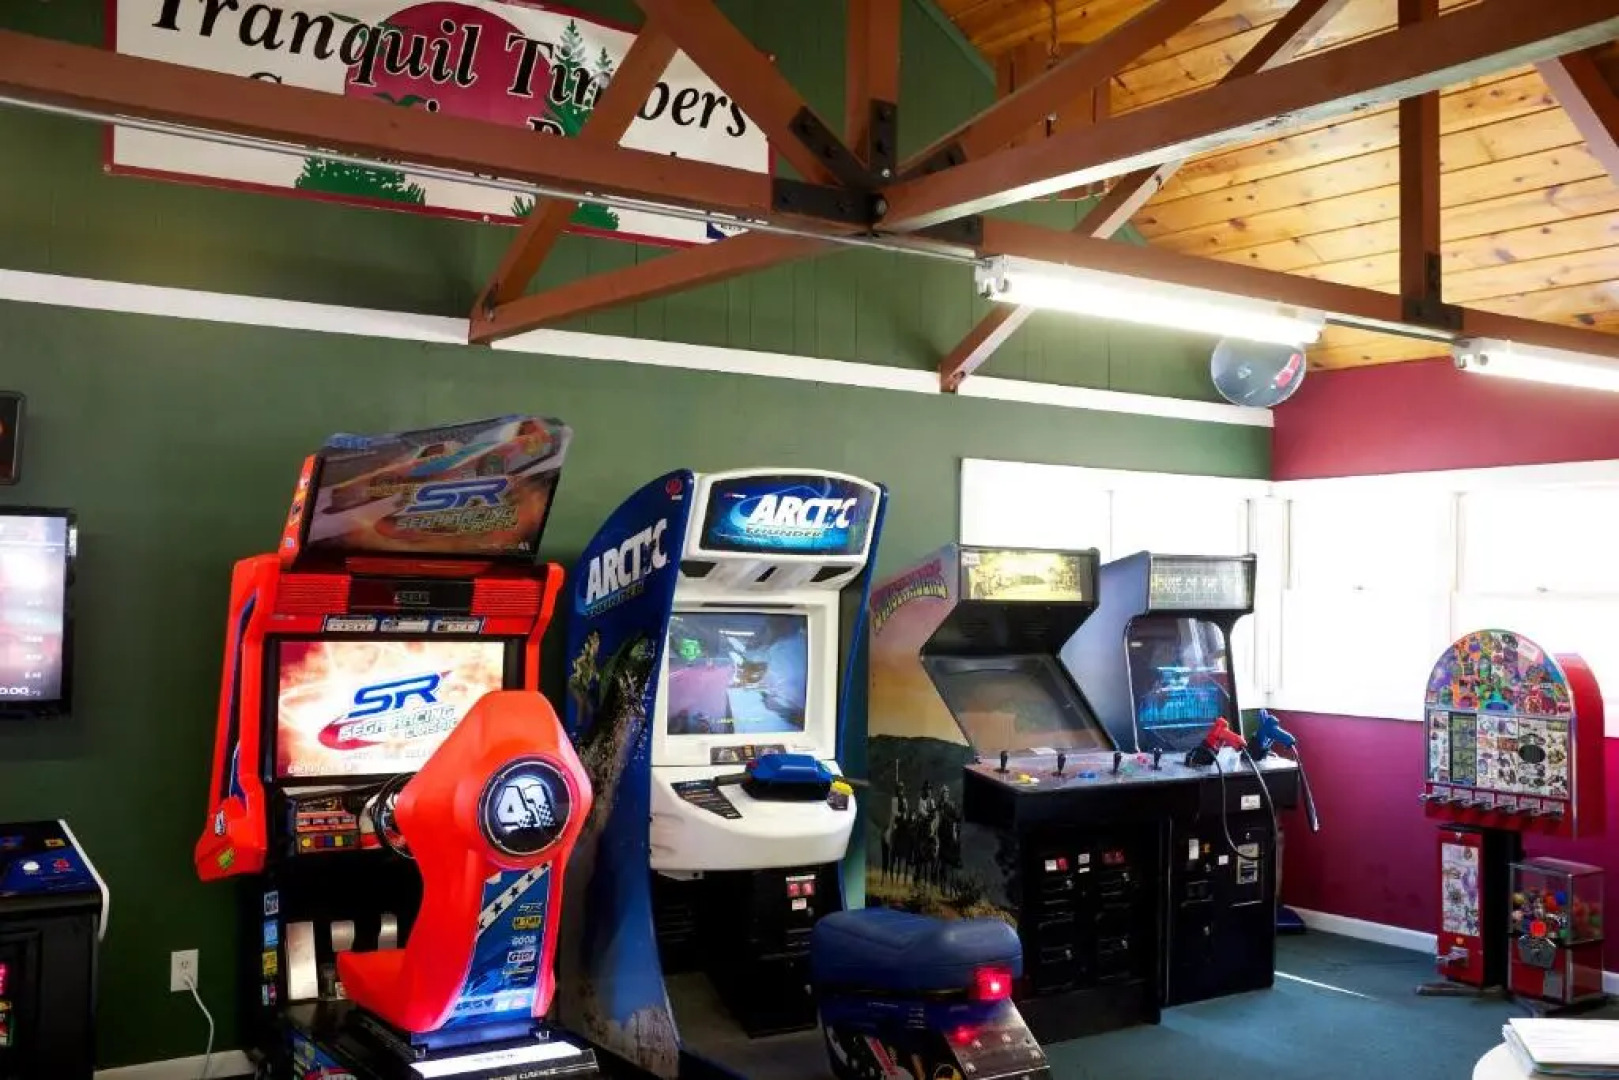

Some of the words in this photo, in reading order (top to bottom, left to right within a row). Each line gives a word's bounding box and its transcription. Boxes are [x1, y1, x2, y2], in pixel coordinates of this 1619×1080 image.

[404, 476, 509, 514] SR
[747, 494, 858, 529] ARCTIC
[585, 518, 668, 605] ARCTIC
[347, 673, 440, 718] SR
[339, 721, 387, 740] SEGA
